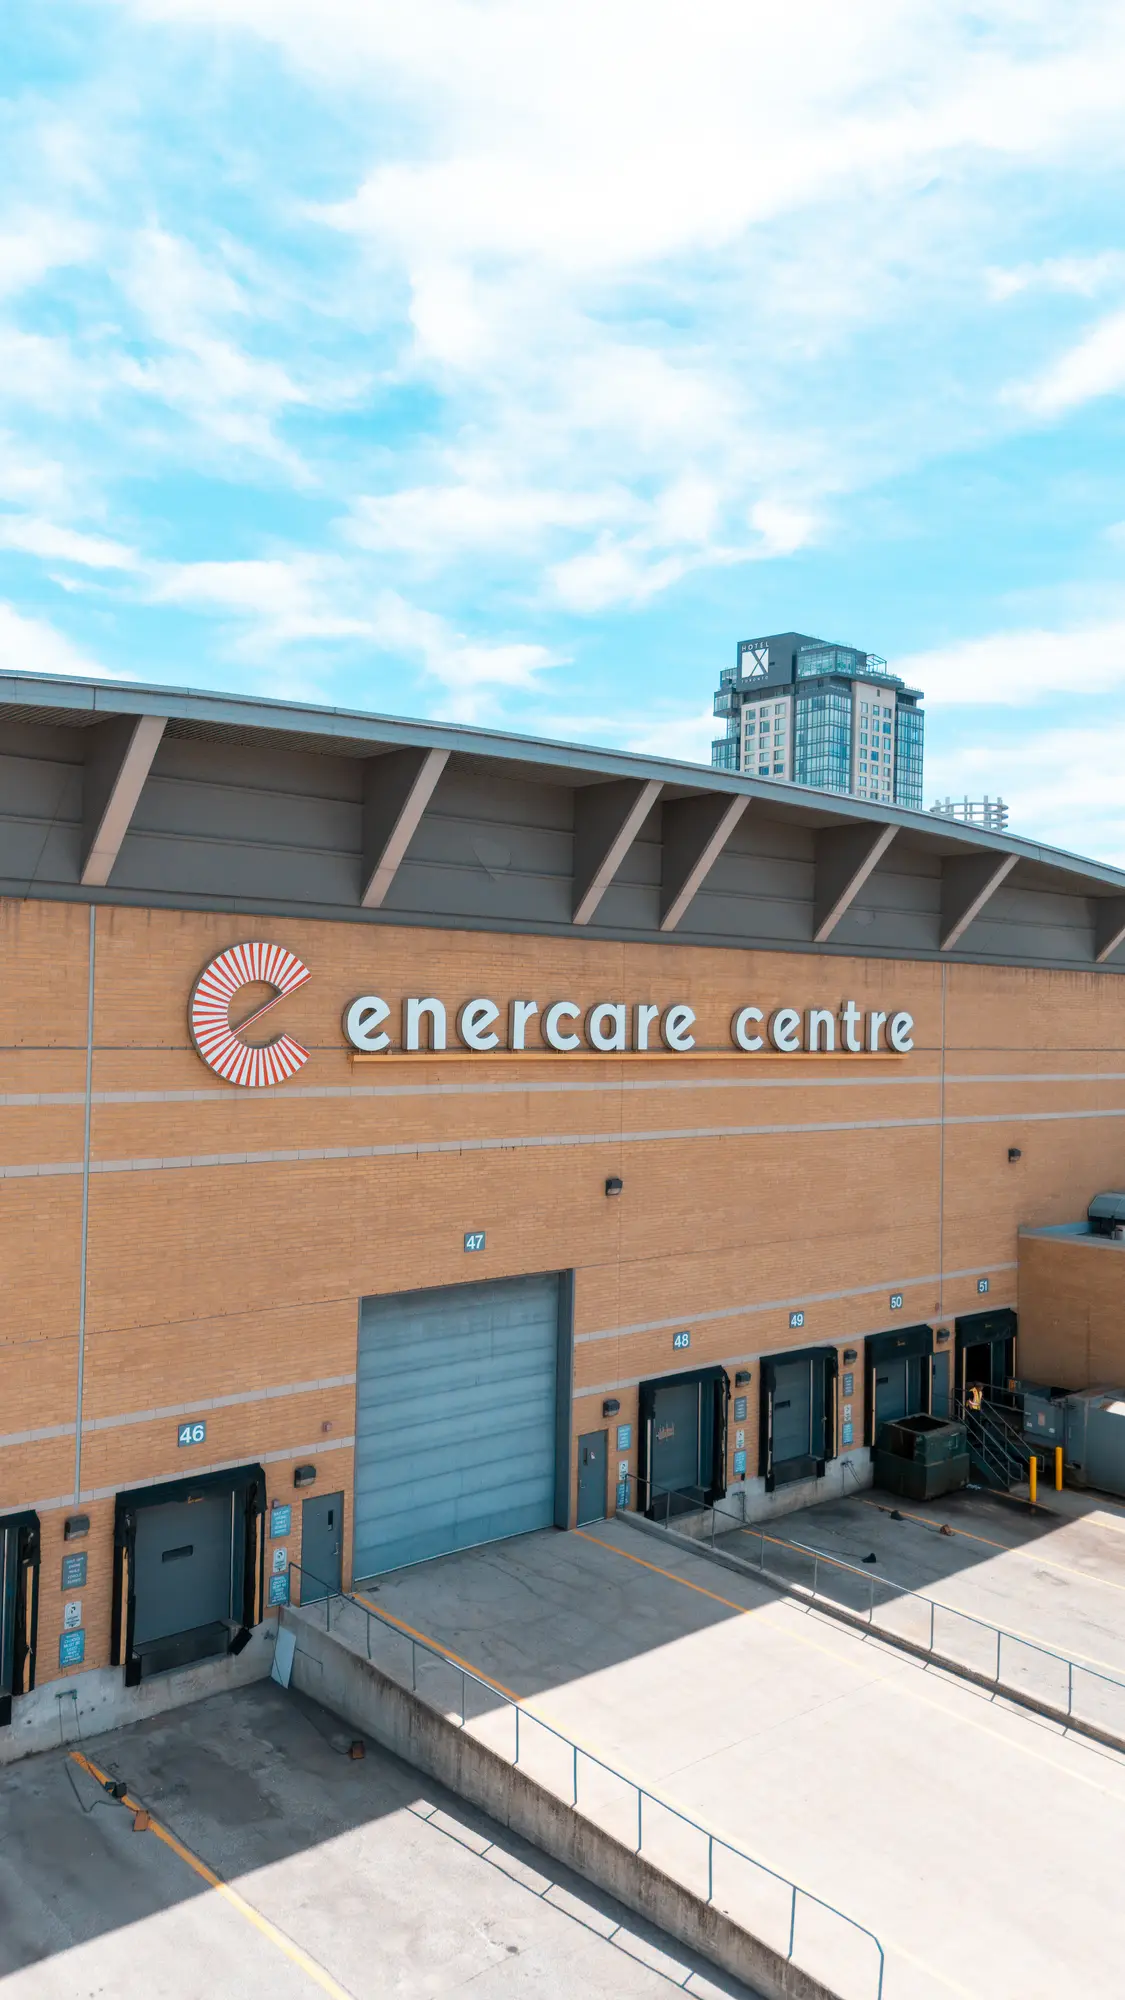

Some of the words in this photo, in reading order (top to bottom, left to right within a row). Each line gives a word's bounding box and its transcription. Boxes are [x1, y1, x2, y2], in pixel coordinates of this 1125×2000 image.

[741, 641, 769, 652] HOTEL
[746, 648, 769, 678] X
[343, 995, 697, 1051] enercare
[732, 1000, 914, 1052] centre
[466, 1234, 484, 1250] 47
[979, 1280, 988, 1292] 51
[891, 1296, 902, 1308] 50
[791, 1313, 804, 1327] 49
[674, 1333, 689, 1348] 48
[179, 1424, 204, 1443] 46
